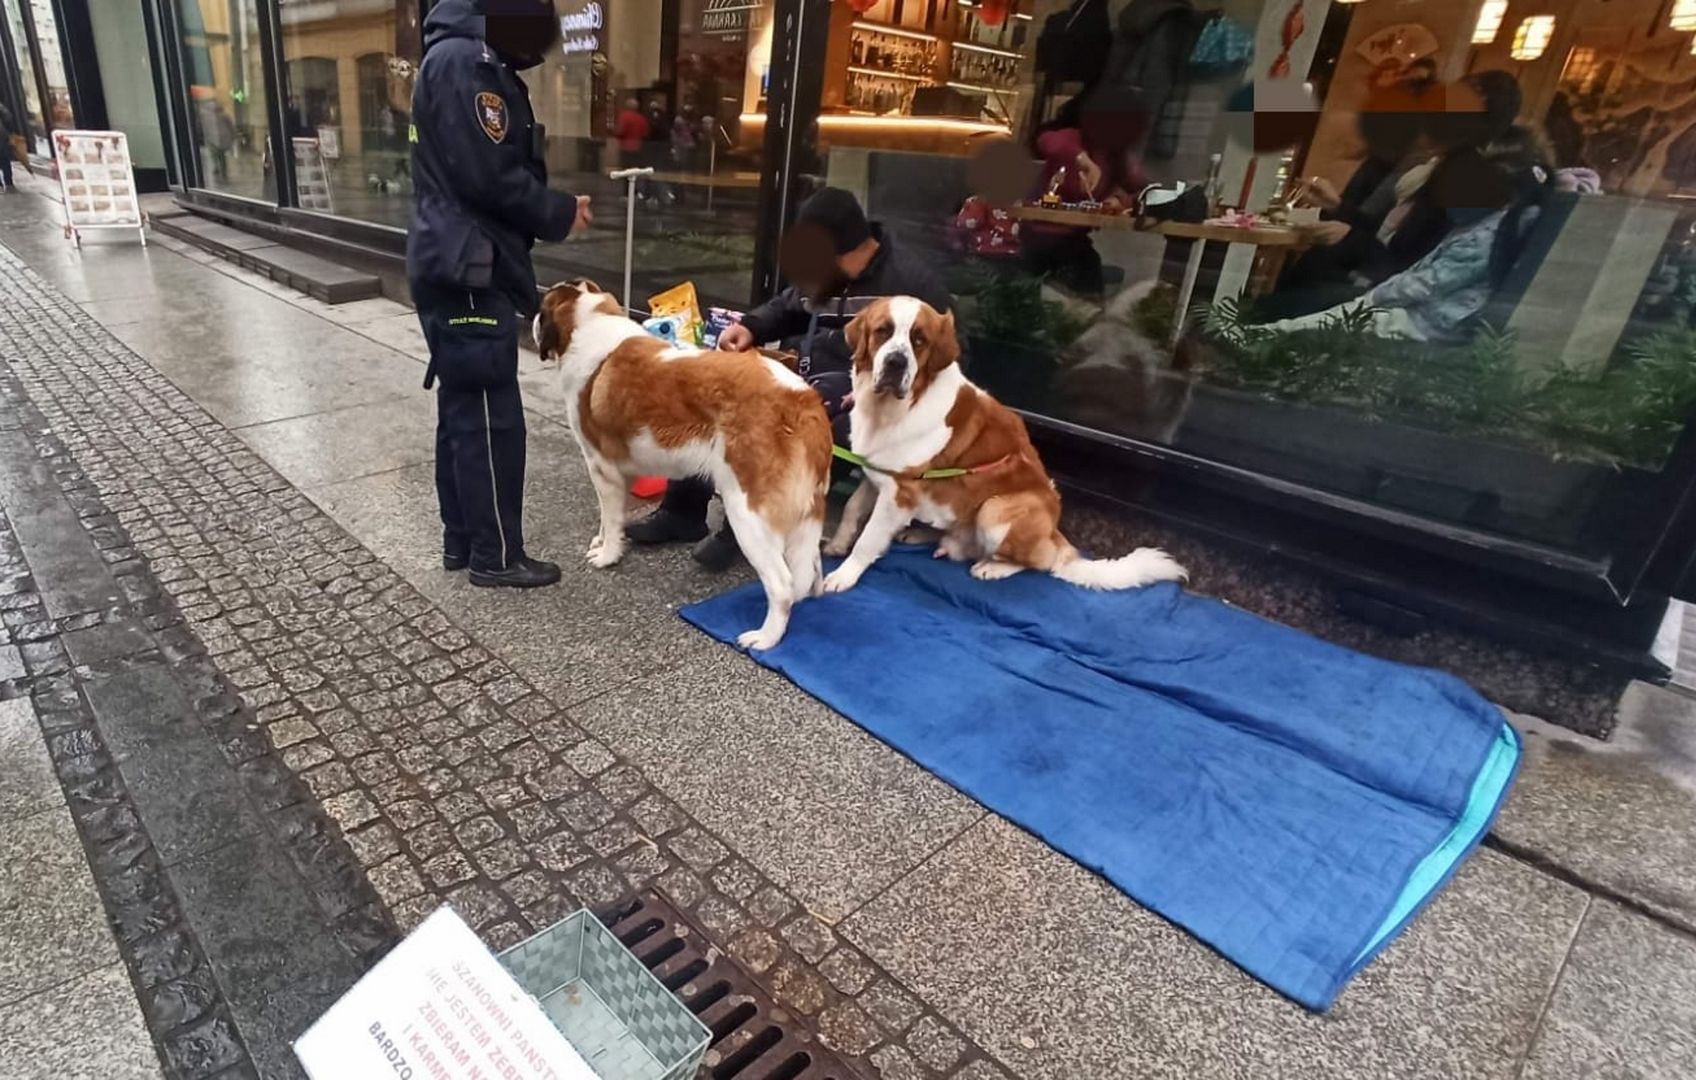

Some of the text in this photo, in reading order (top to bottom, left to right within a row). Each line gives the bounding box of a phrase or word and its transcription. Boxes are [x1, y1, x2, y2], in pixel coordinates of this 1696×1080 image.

[444, 994, 492, 1049] JESTEM
[452, 960, 513, 1031] SZANOWNI
[368, 1020, 413, 1080] BARDZO
[402, 1023, 413, 1035] I
[418, 1000, 471, 1067] ZBIERAM
